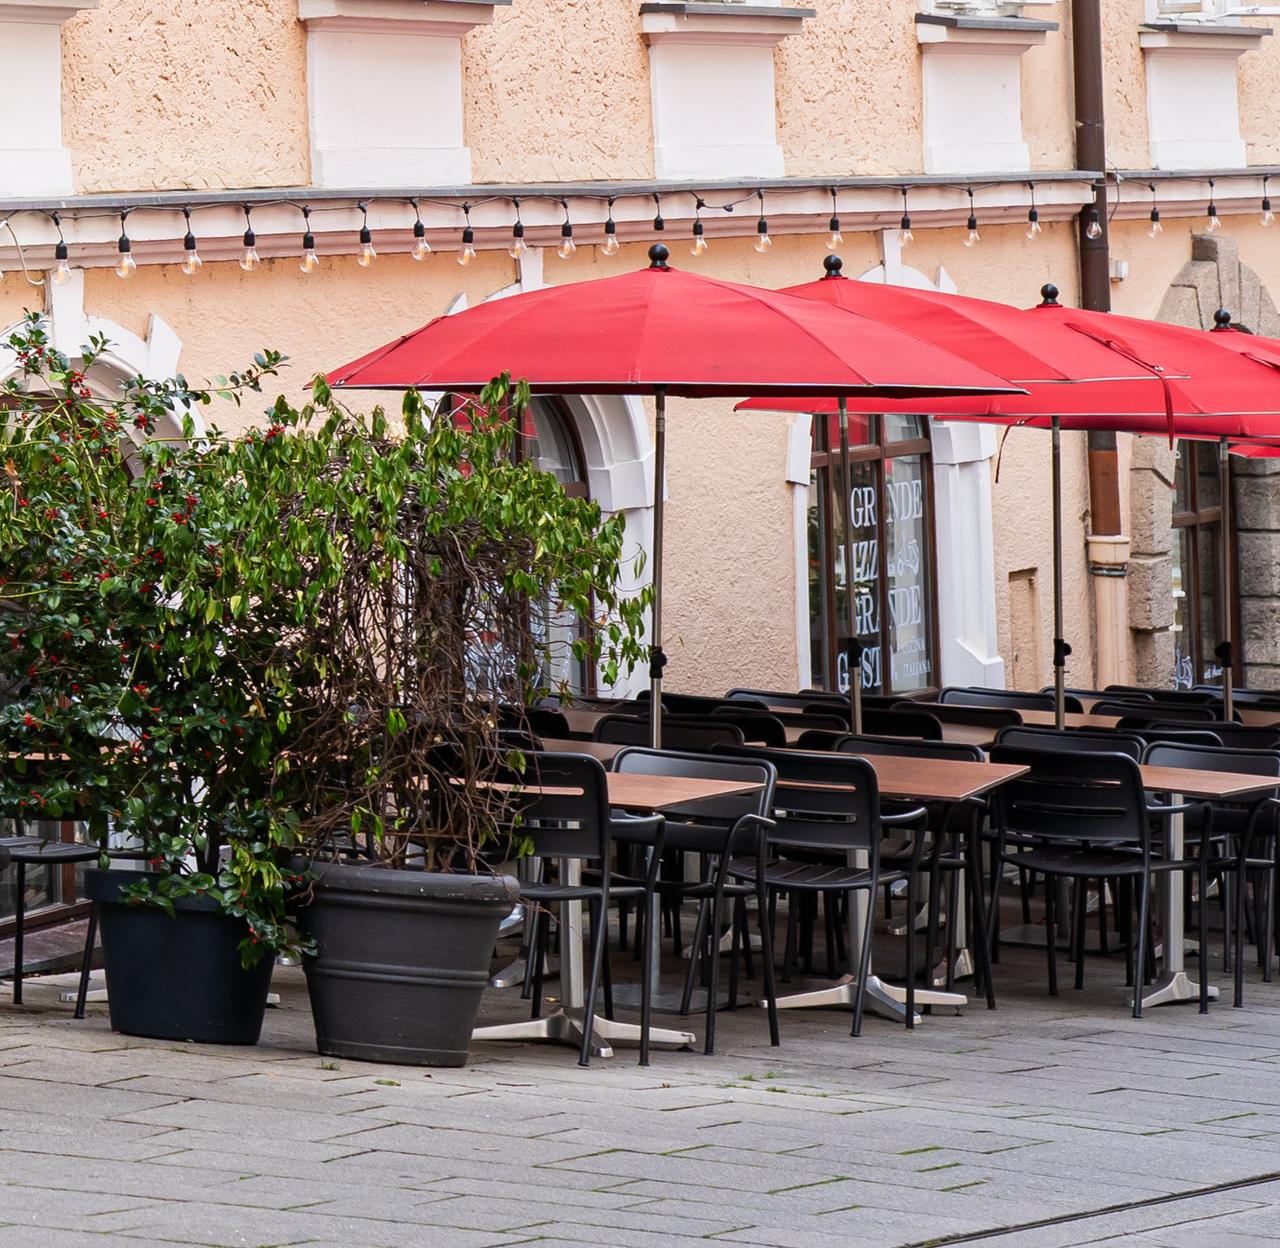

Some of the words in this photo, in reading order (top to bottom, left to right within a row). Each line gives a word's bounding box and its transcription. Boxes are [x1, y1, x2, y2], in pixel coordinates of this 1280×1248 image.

[850, 479, 923, 529] GRNDE
[838, 539, 880, 585] IZZ
[854, 585, 922, 636] RNDE
[837, 646, 897, 694] GST
